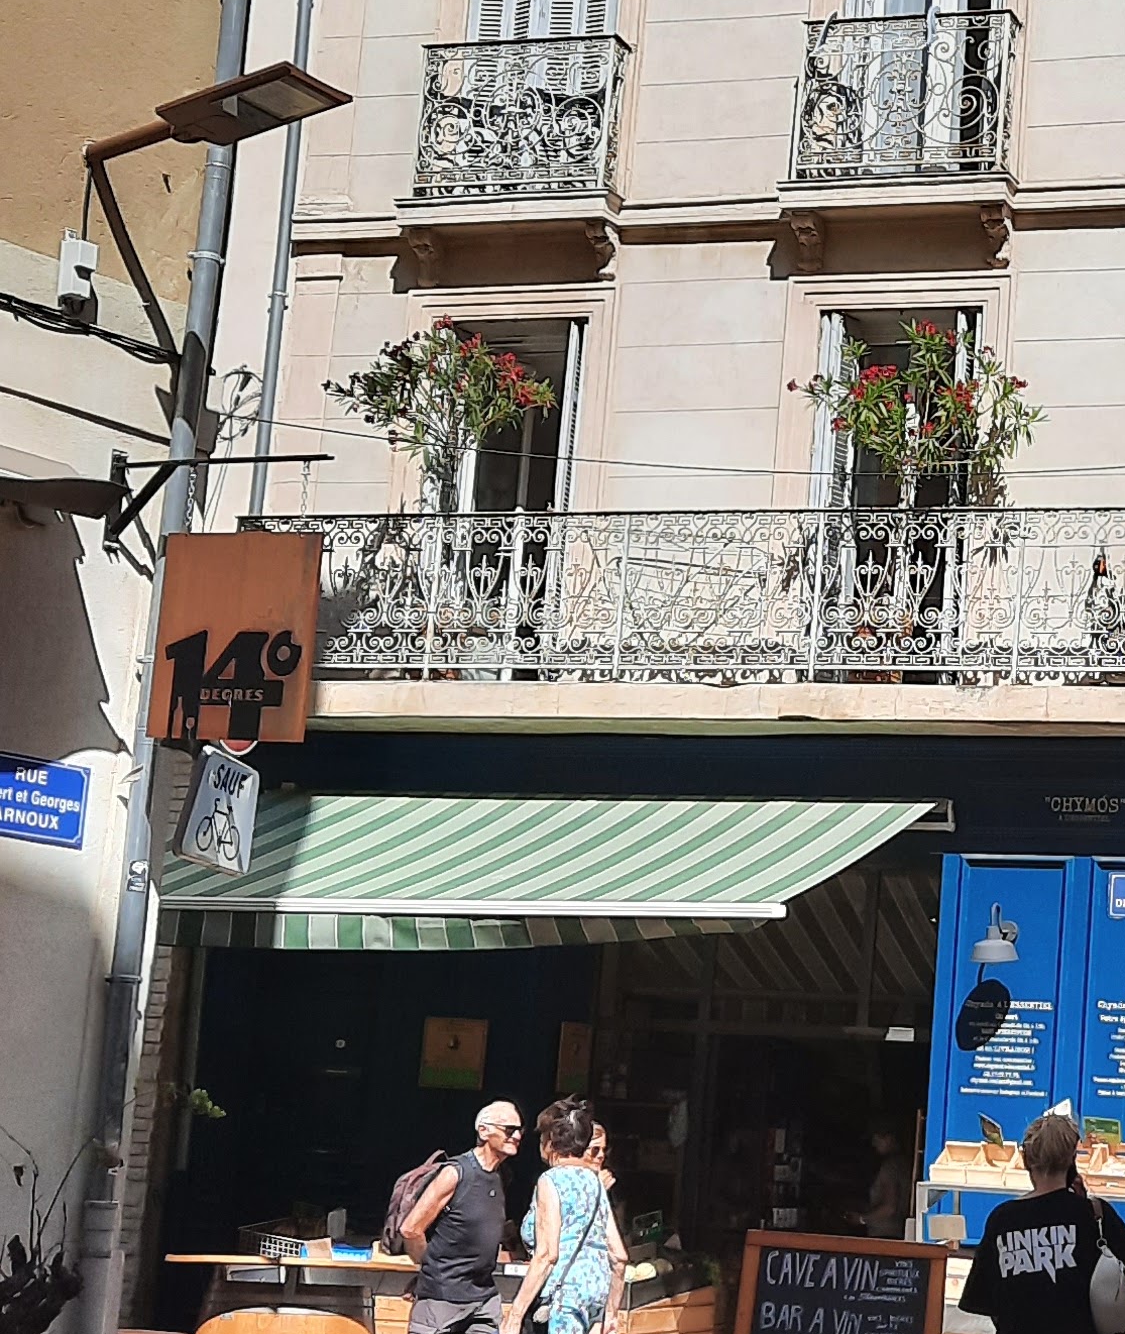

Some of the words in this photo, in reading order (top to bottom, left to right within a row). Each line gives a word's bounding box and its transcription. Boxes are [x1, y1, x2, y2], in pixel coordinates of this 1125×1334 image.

[15, 766, 49, 786] RUE
[214, 764, 248, 798] SAUF
[15, 789, 28, 803] et
[31, 790, 80, 813] Georges
[0, 806, 60, 830] RNOUX
[997, 1224, 1077, 1255] LINKIN
[766, 1250, 821, 1288] CAVE
[820, 1257, 838, 1289] A
[843, 1256, 880, 1291] VIN
[999, 1244, 1077, 1283] PARK
[760, 1301, 803, 1331] BAR
[808, 1307, 825, 1334] A
